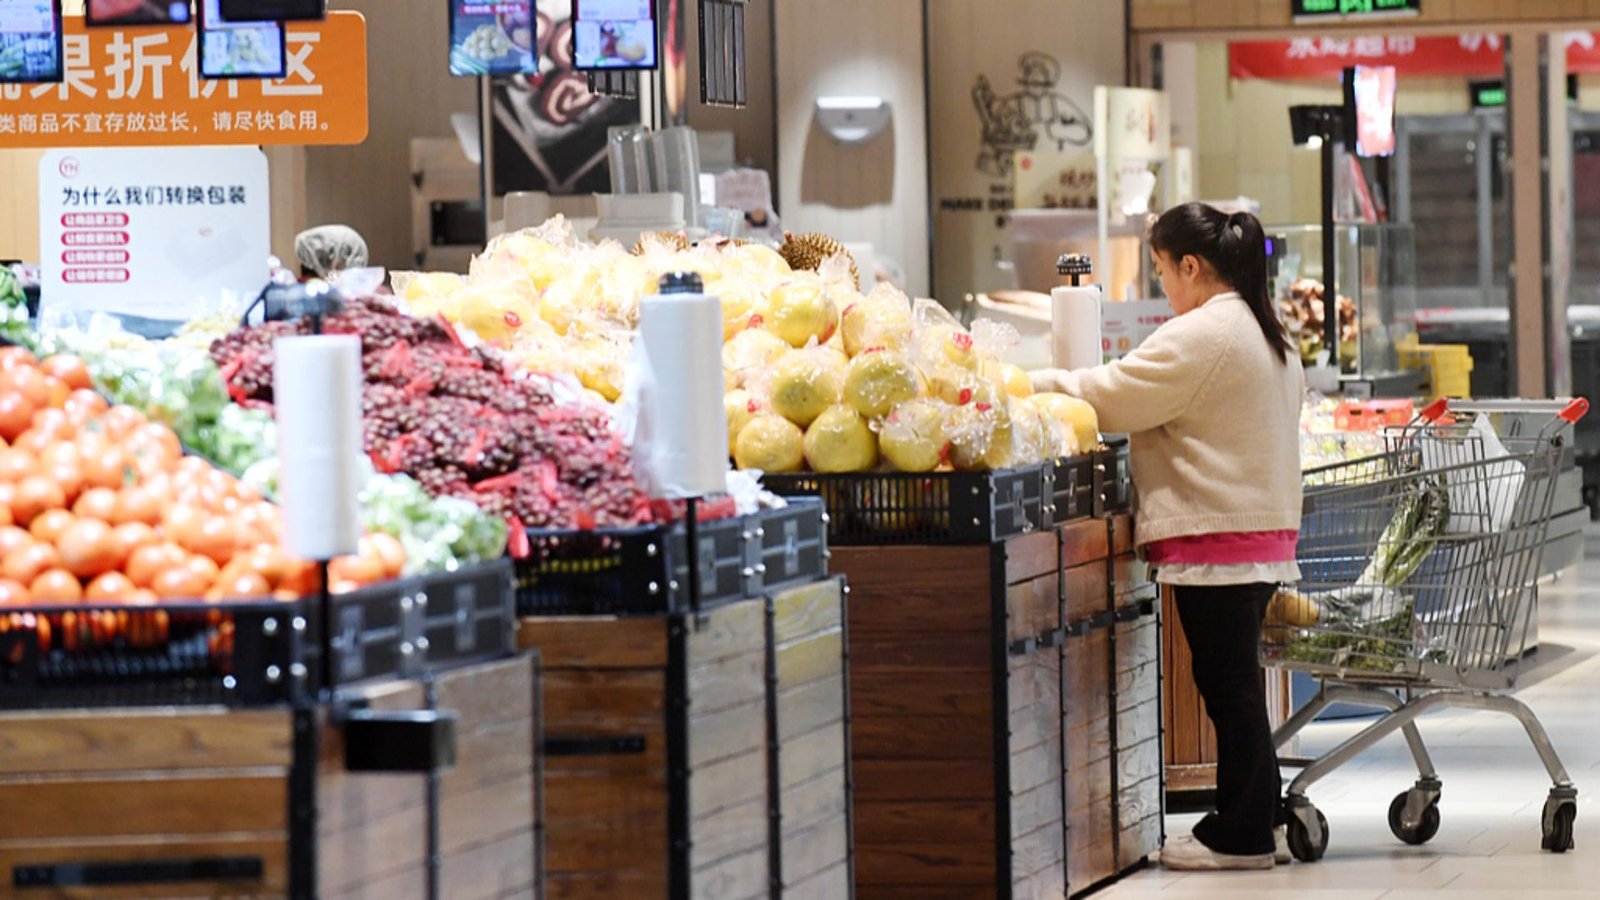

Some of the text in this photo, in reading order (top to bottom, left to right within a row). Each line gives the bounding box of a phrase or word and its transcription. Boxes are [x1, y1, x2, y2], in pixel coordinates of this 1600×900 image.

[0, 31, 323, 101] 果折价区
[62, 185, 247, 206] 为什么我们转换包装
